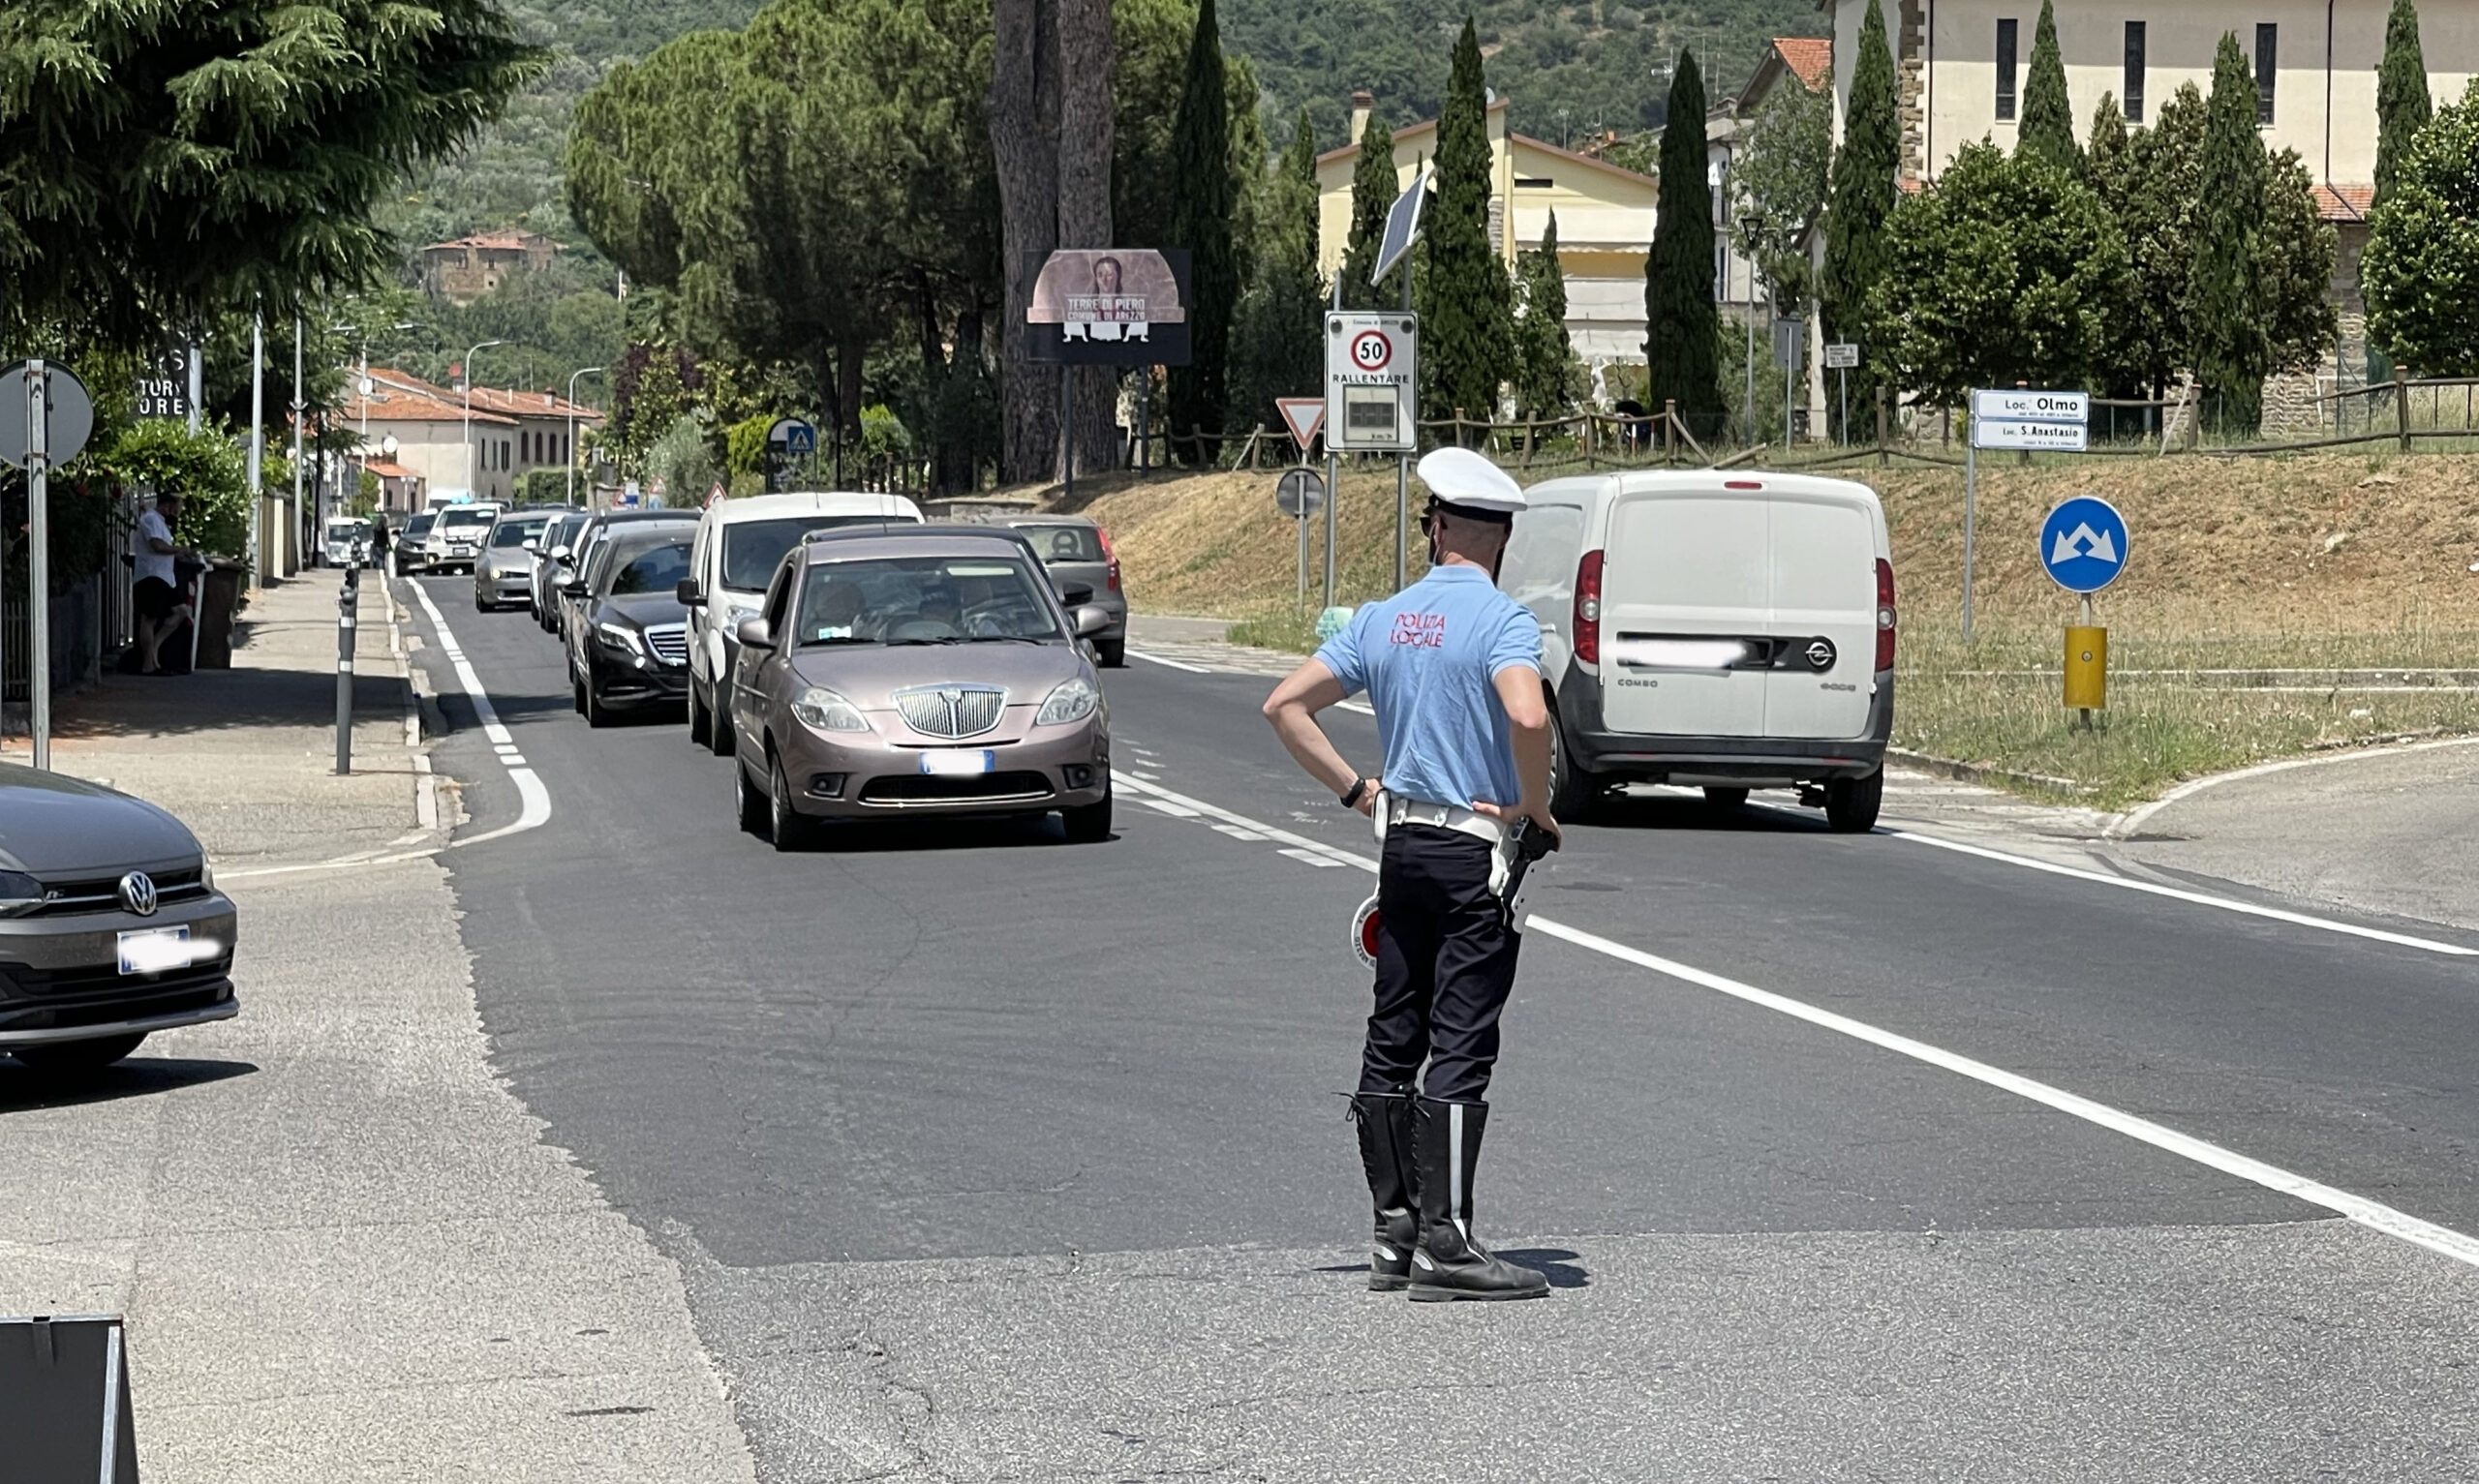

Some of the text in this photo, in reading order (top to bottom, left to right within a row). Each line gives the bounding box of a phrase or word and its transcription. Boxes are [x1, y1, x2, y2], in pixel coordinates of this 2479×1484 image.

[1068, 298, 1099, 311] TERRE
[1116, 311, 1146, 320] AREZZO
[1361, 342, 1383, 360] 50
[1332, 374, 1409, 384] RALLENTARE
[2005, 397, 2078, 411] Loc. Olmo
[1394, 613, 1445, 630] POLIZIA
[1390, 629, 1443, 648] LOCALE
